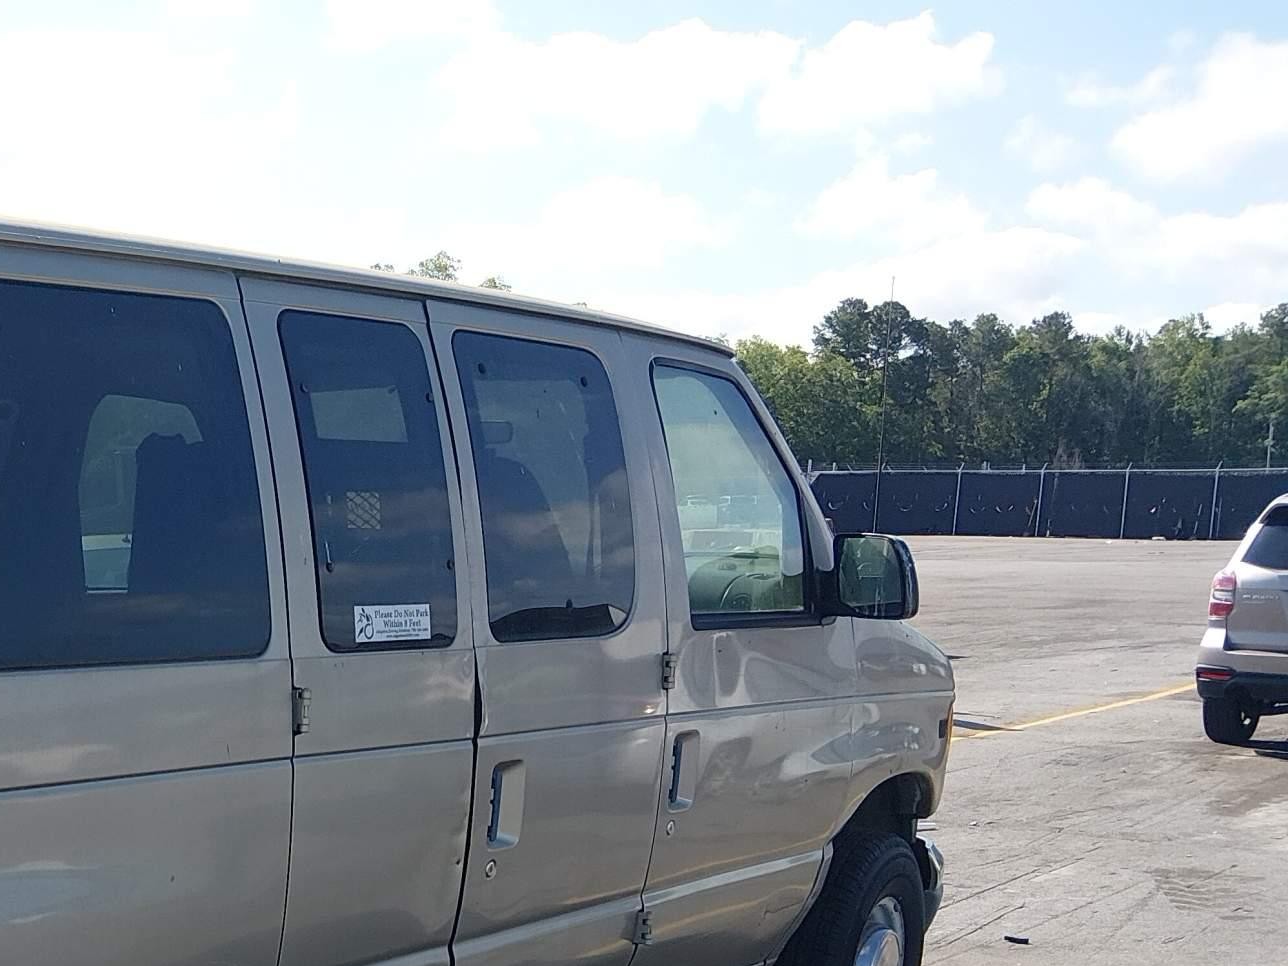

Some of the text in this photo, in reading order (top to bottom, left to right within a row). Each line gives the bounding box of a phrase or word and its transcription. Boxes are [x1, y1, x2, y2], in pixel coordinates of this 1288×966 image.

[374, 608, 428, 618] Please Do Not Park
[383, 619, 403, 628] Within
[409, 618, 422, 628] Feet
